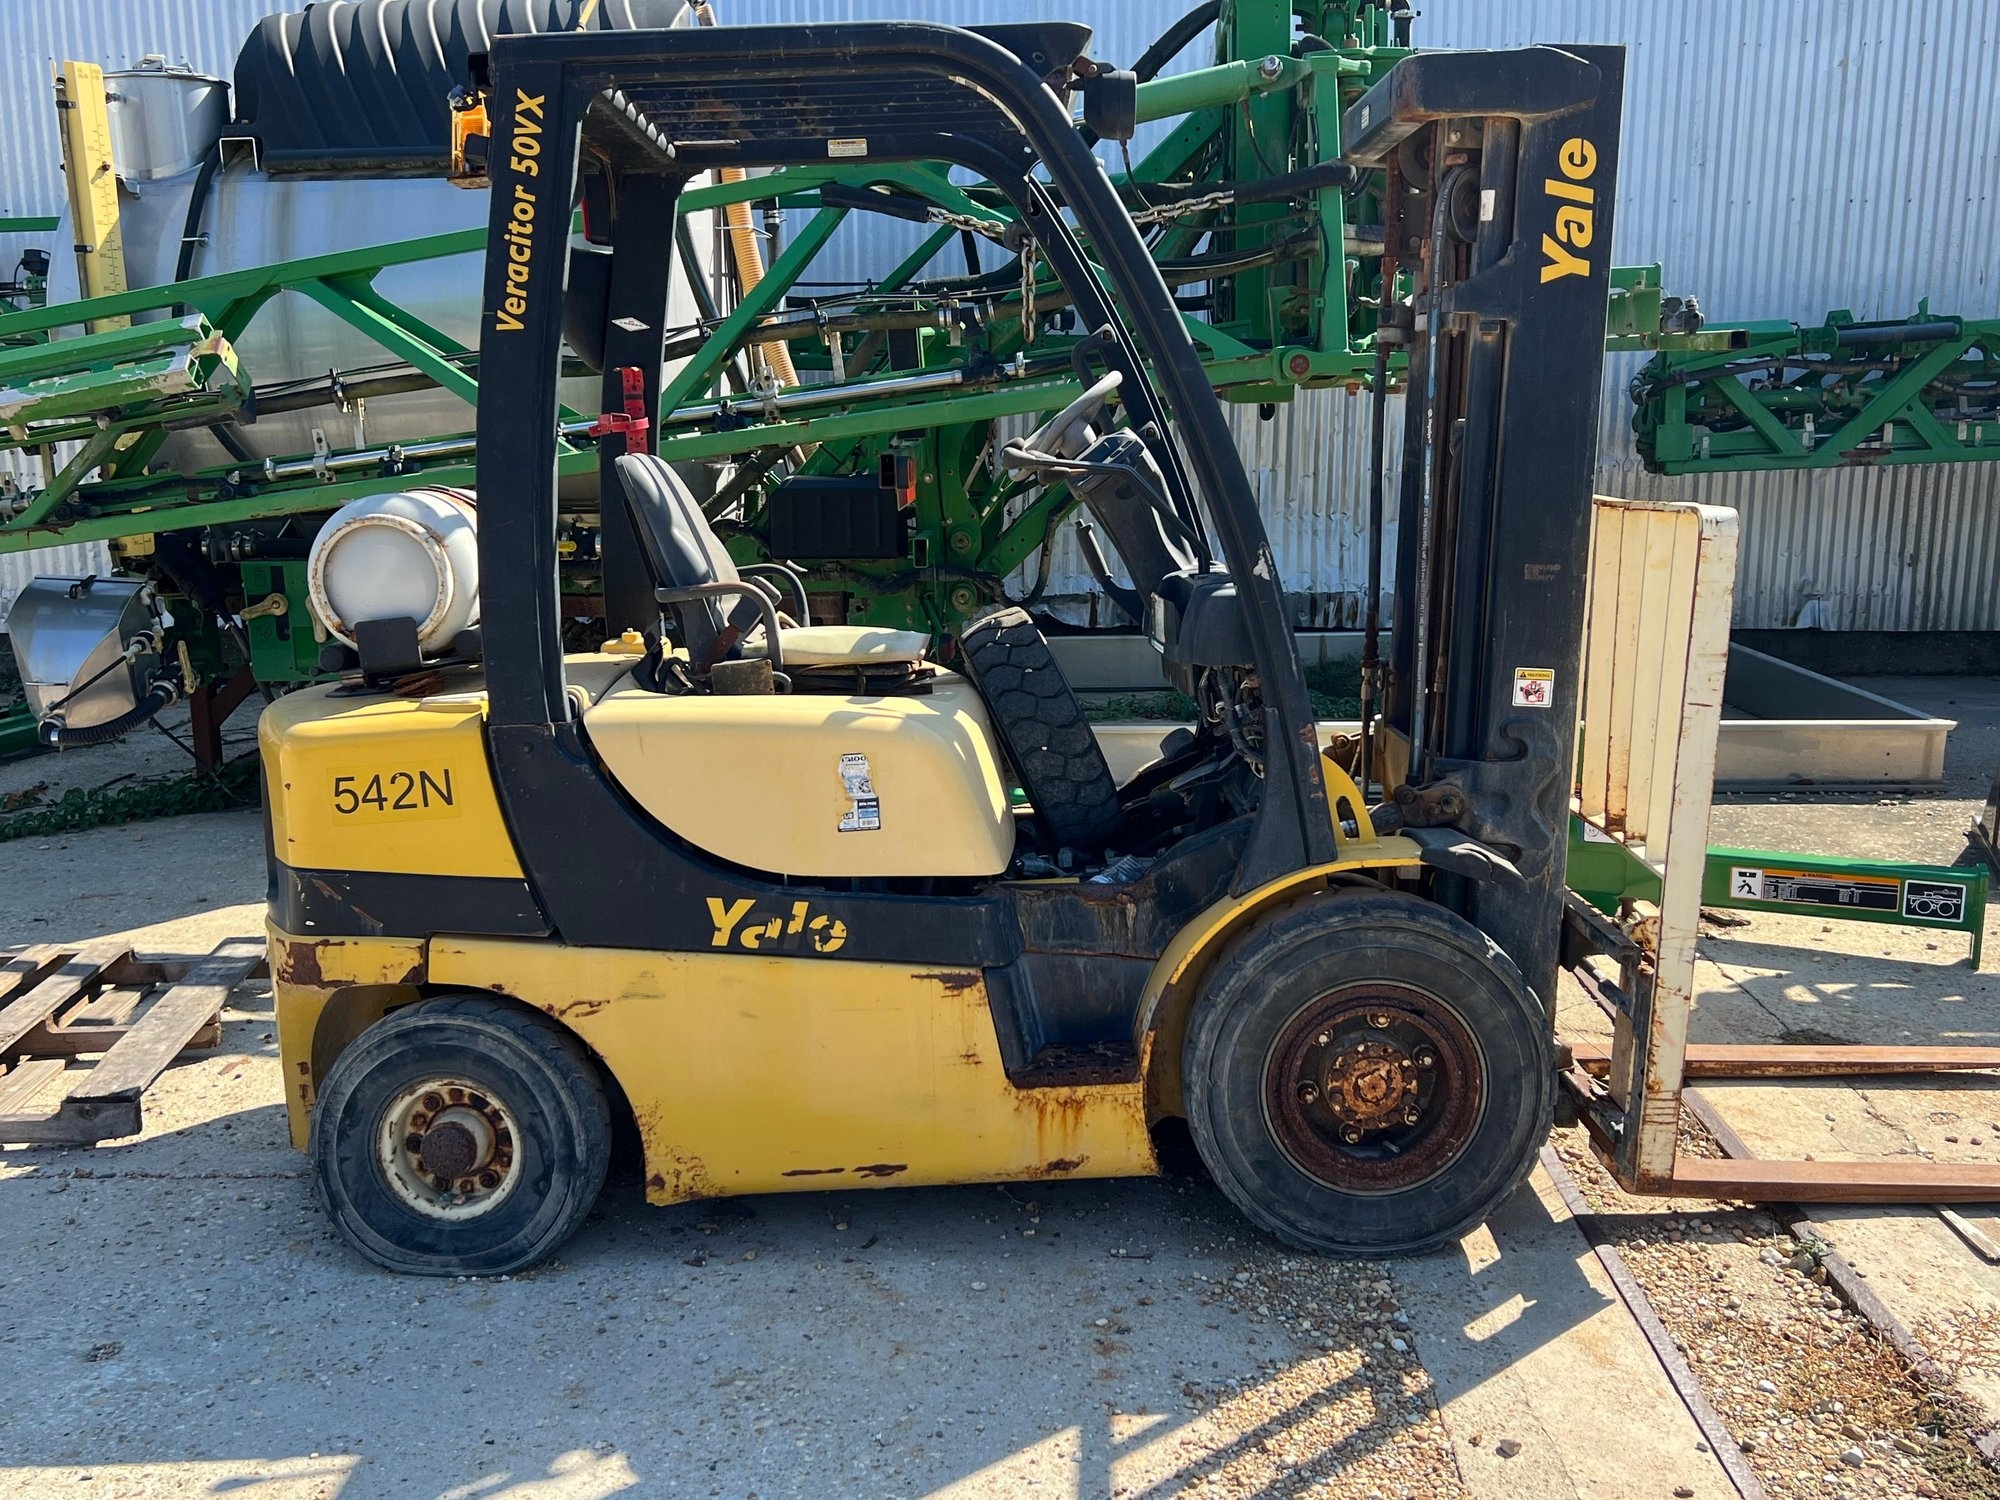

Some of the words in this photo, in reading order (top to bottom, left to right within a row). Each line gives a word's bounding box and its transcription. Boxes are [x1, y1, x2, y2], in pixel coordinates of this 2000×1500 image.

[510, 88, 545, 178] 50VX
[496, 184, 536, 331] Veracitor
[1541, 137, 1597, 284] Yale
[334, 768, 454, 814] 542N
